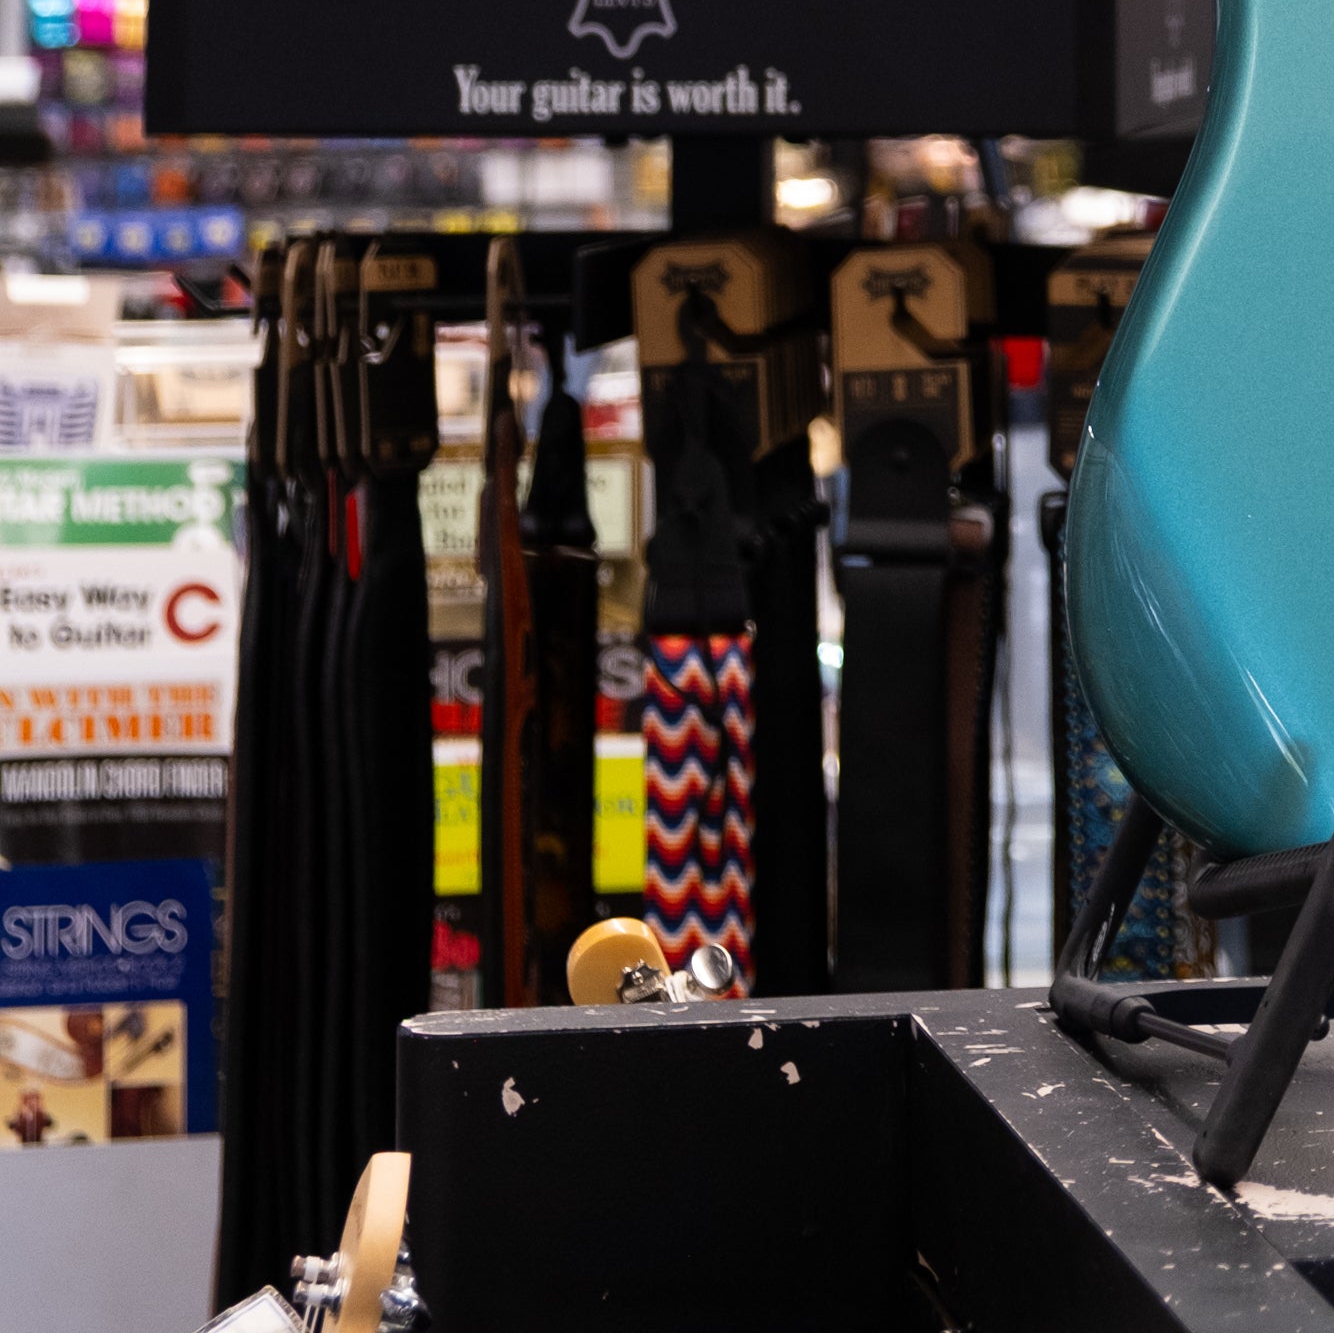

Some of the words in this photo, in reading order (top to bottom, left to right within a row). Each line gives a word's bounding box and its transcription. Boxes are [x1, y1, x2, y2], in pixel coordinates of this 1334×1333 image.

[453, 64, 526, 115] Your
[531, 66, 625, 122] guitar
[629, 66, 662, 115] is
[666, 64, 760, 115] worth
[764, 66, 802, 115] it.
[163, 583, 222, 644] C
[1, 898, 188, 960] STRINGS
